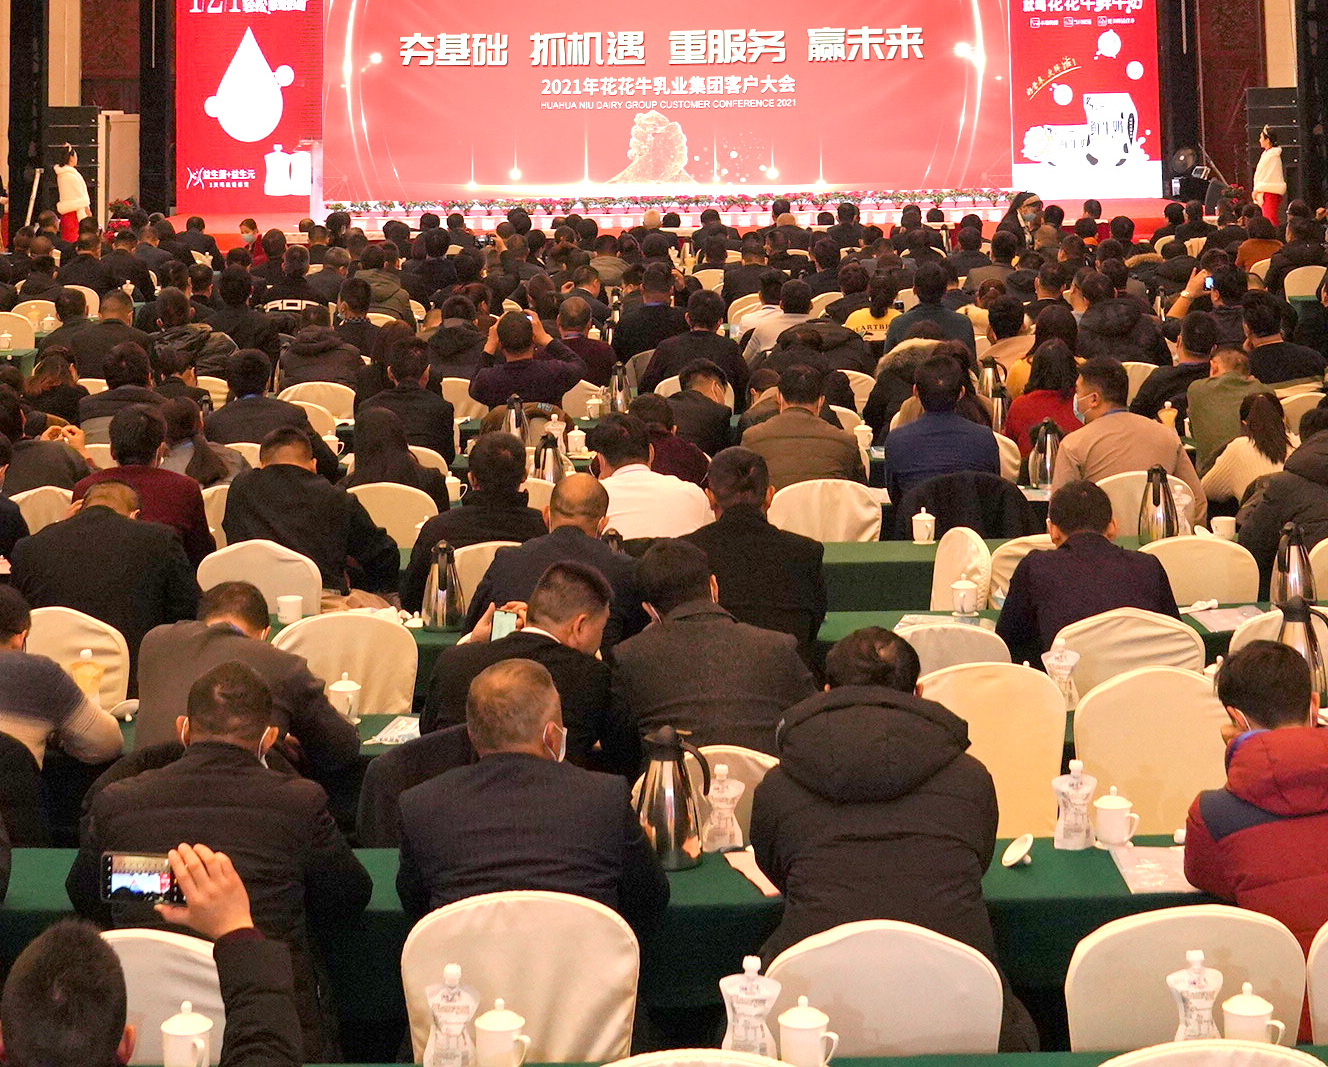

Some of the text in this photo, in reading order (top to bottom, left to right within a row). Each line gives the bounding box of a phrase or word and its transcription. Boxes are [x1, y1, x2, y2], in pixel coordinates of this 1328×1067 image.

[400, 25, 924, 67] 夯基础 抓机遇 重服务 赢未来
[541, 74, 796, 95] 2021年花花牛乳业集团客户大会
[540, 98, 796, 109] HUAHUA NIU DAIRY GROUP CUSTOMER CONFERENCE 2021
